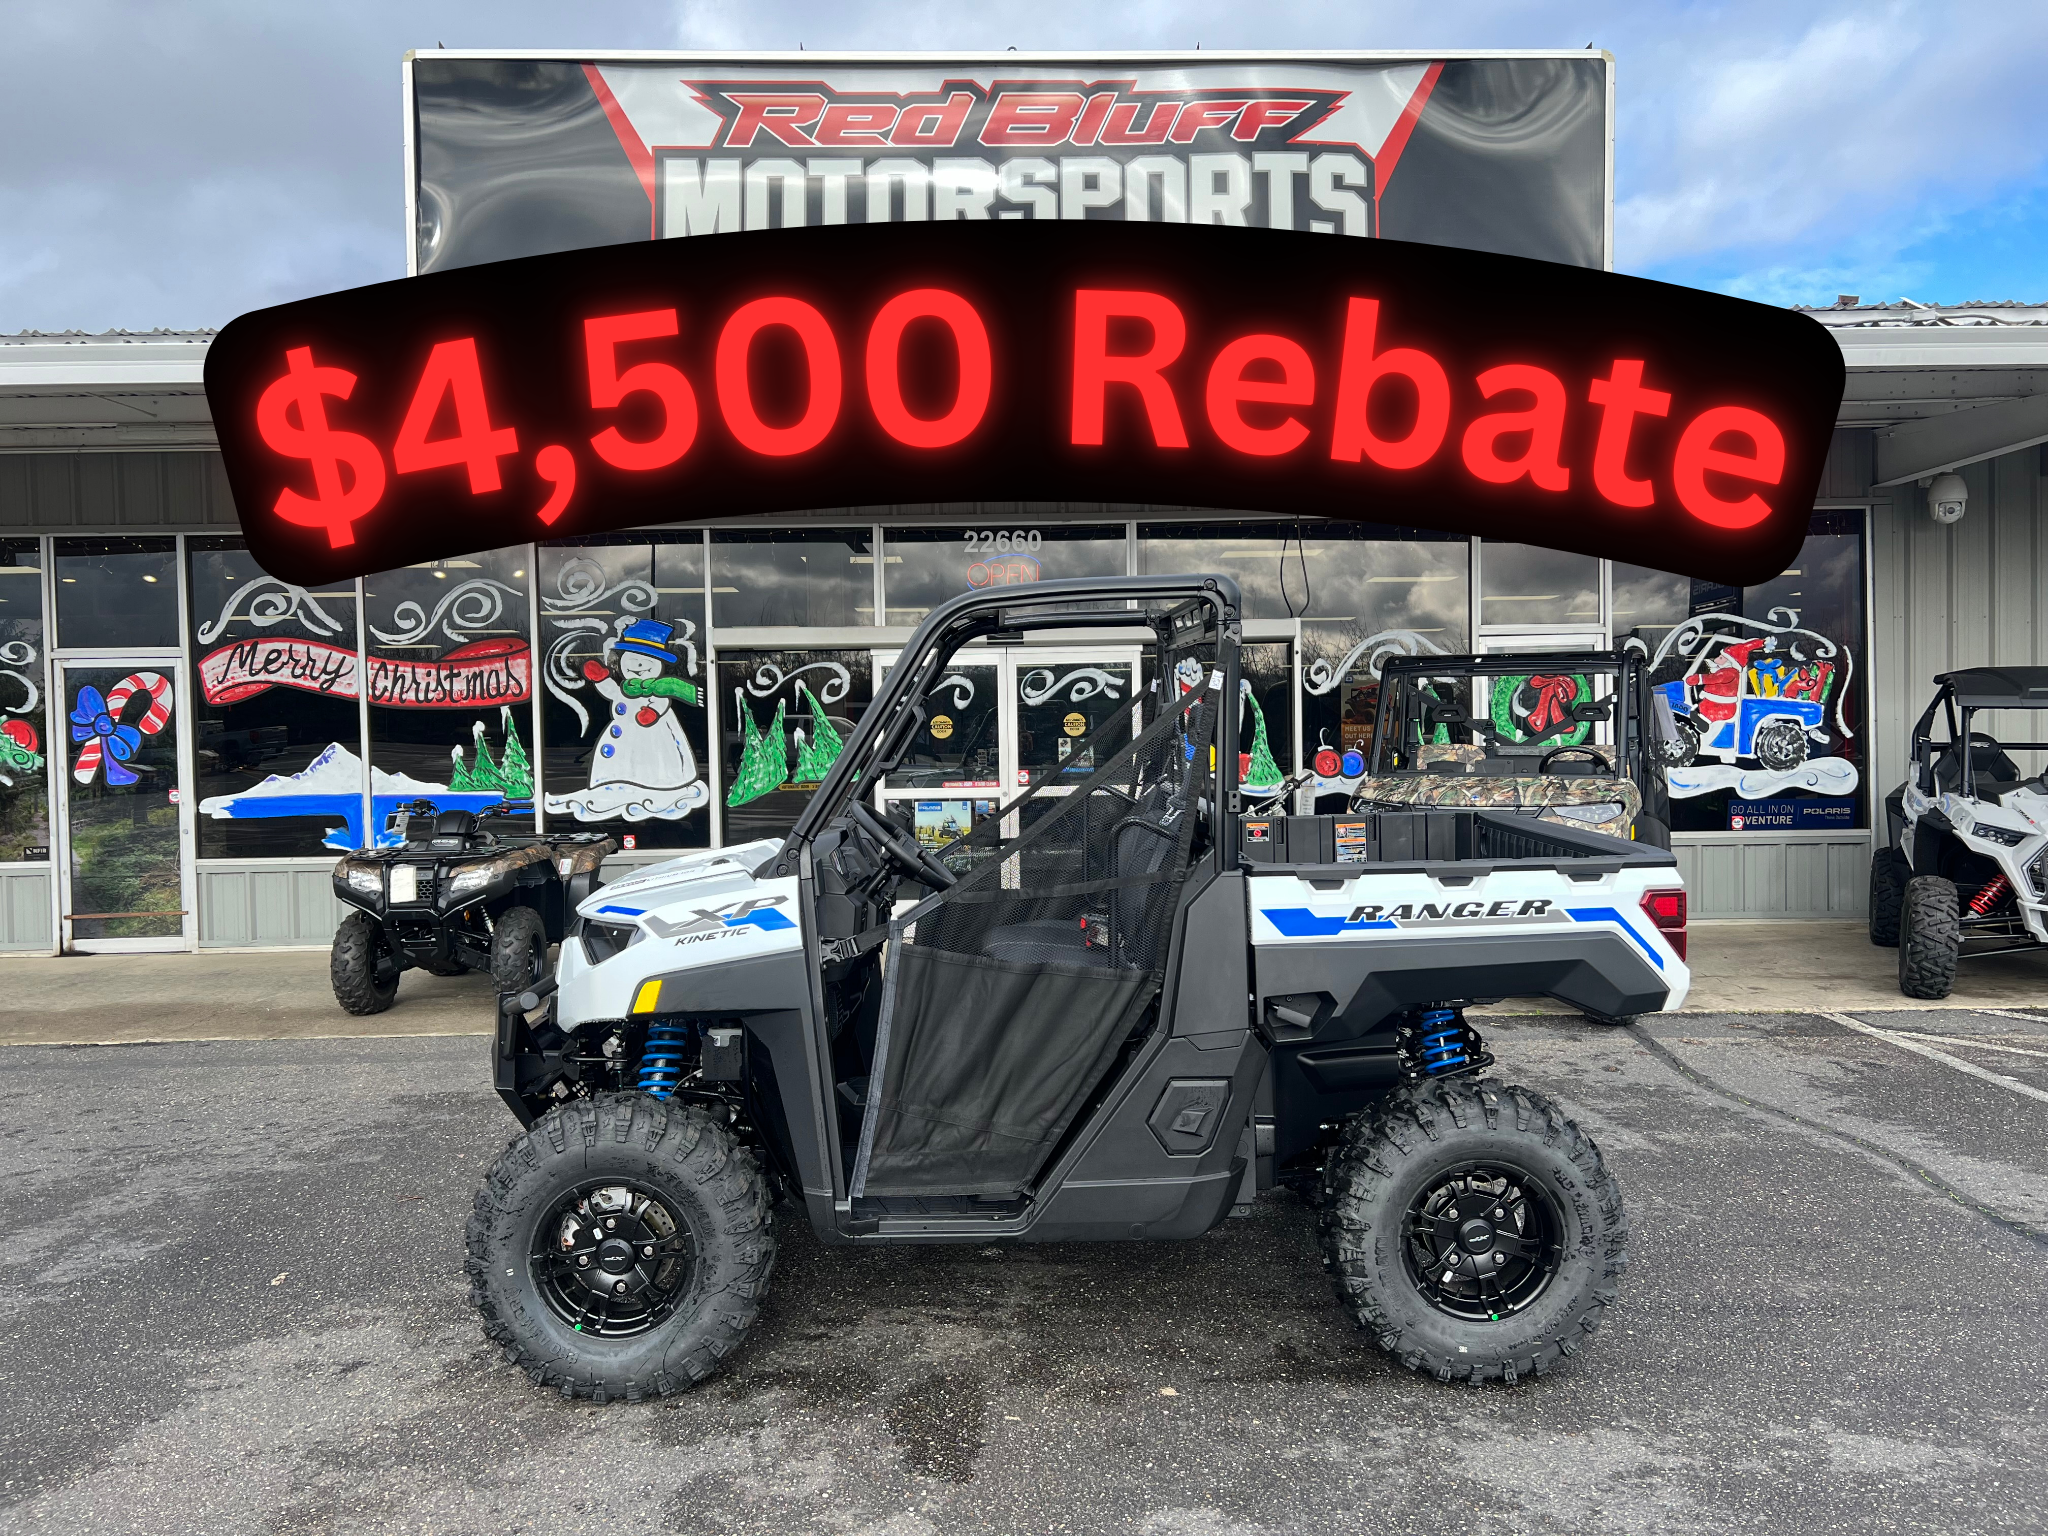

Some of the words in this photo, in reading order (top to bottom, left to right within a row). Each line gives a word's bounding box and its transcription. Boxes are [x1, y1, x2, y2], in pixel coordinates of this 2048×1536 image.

[719, 92, 976, 147] Red
[663, 152, 1368, 239] MOTORSPORTS
[964, 530, 1041, 552] 22660
[967, 563, 1039, 586] OPEN
[217, 642, 354, 692] Merry
[372, 657, 524, 703] Christmas
[1731, 805, 1744, 814] GO
[1747, 805, 1766, 814] ALL
[1768, 805, 1778, 814] IN
[1780, 804, 1794, 814] ON
[1742, 815, 1793, 825] VENTURE
[1803, 807, 1851, 815] POLARIS
[1346, 899, 1553, 922] RANGER
[674, 927, 750, 946] KINETIC
